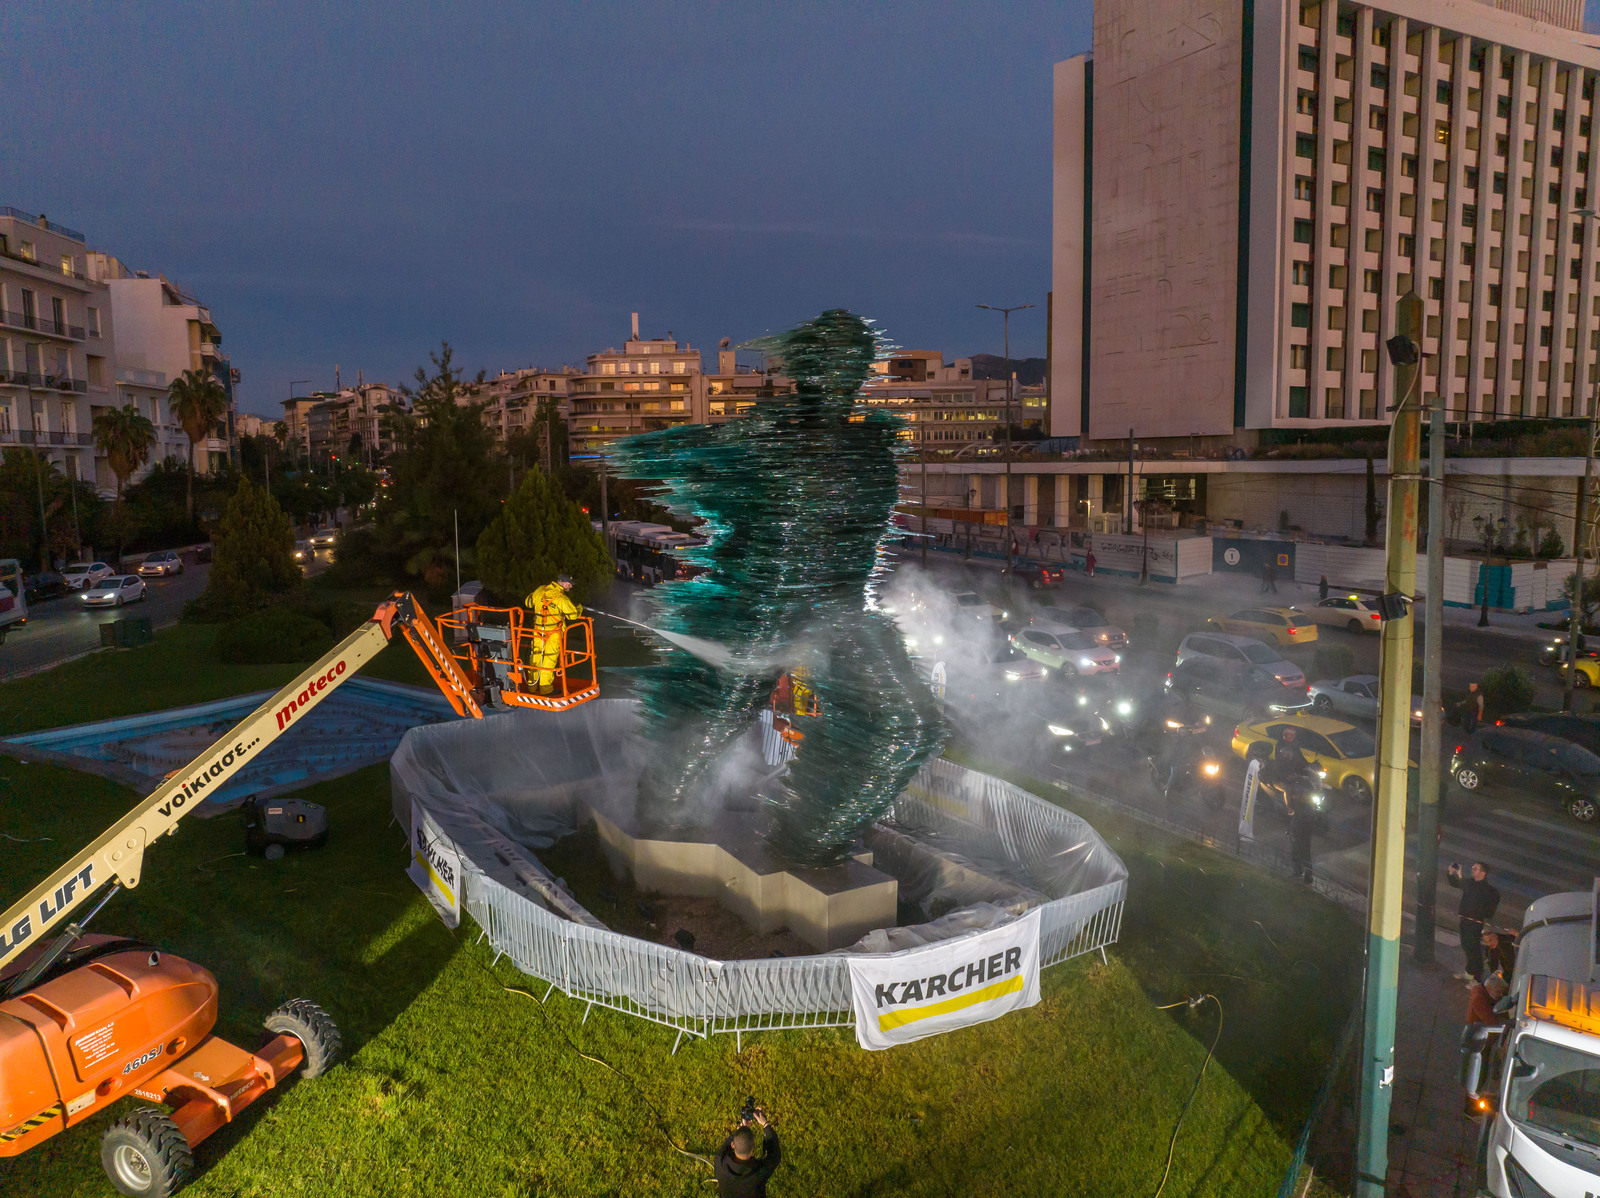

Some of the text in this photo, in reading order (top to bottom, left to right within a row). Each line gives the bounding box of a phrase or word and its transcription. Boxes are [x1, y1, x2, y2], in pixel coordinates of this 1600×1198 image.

[275, 660, 347, 731] mateco
[0, 862, 94, 960] LG LIFT
[874, 946, 1022, 1009] KÄRCHER
[122, 1043, 163, 1075] 460SJ
